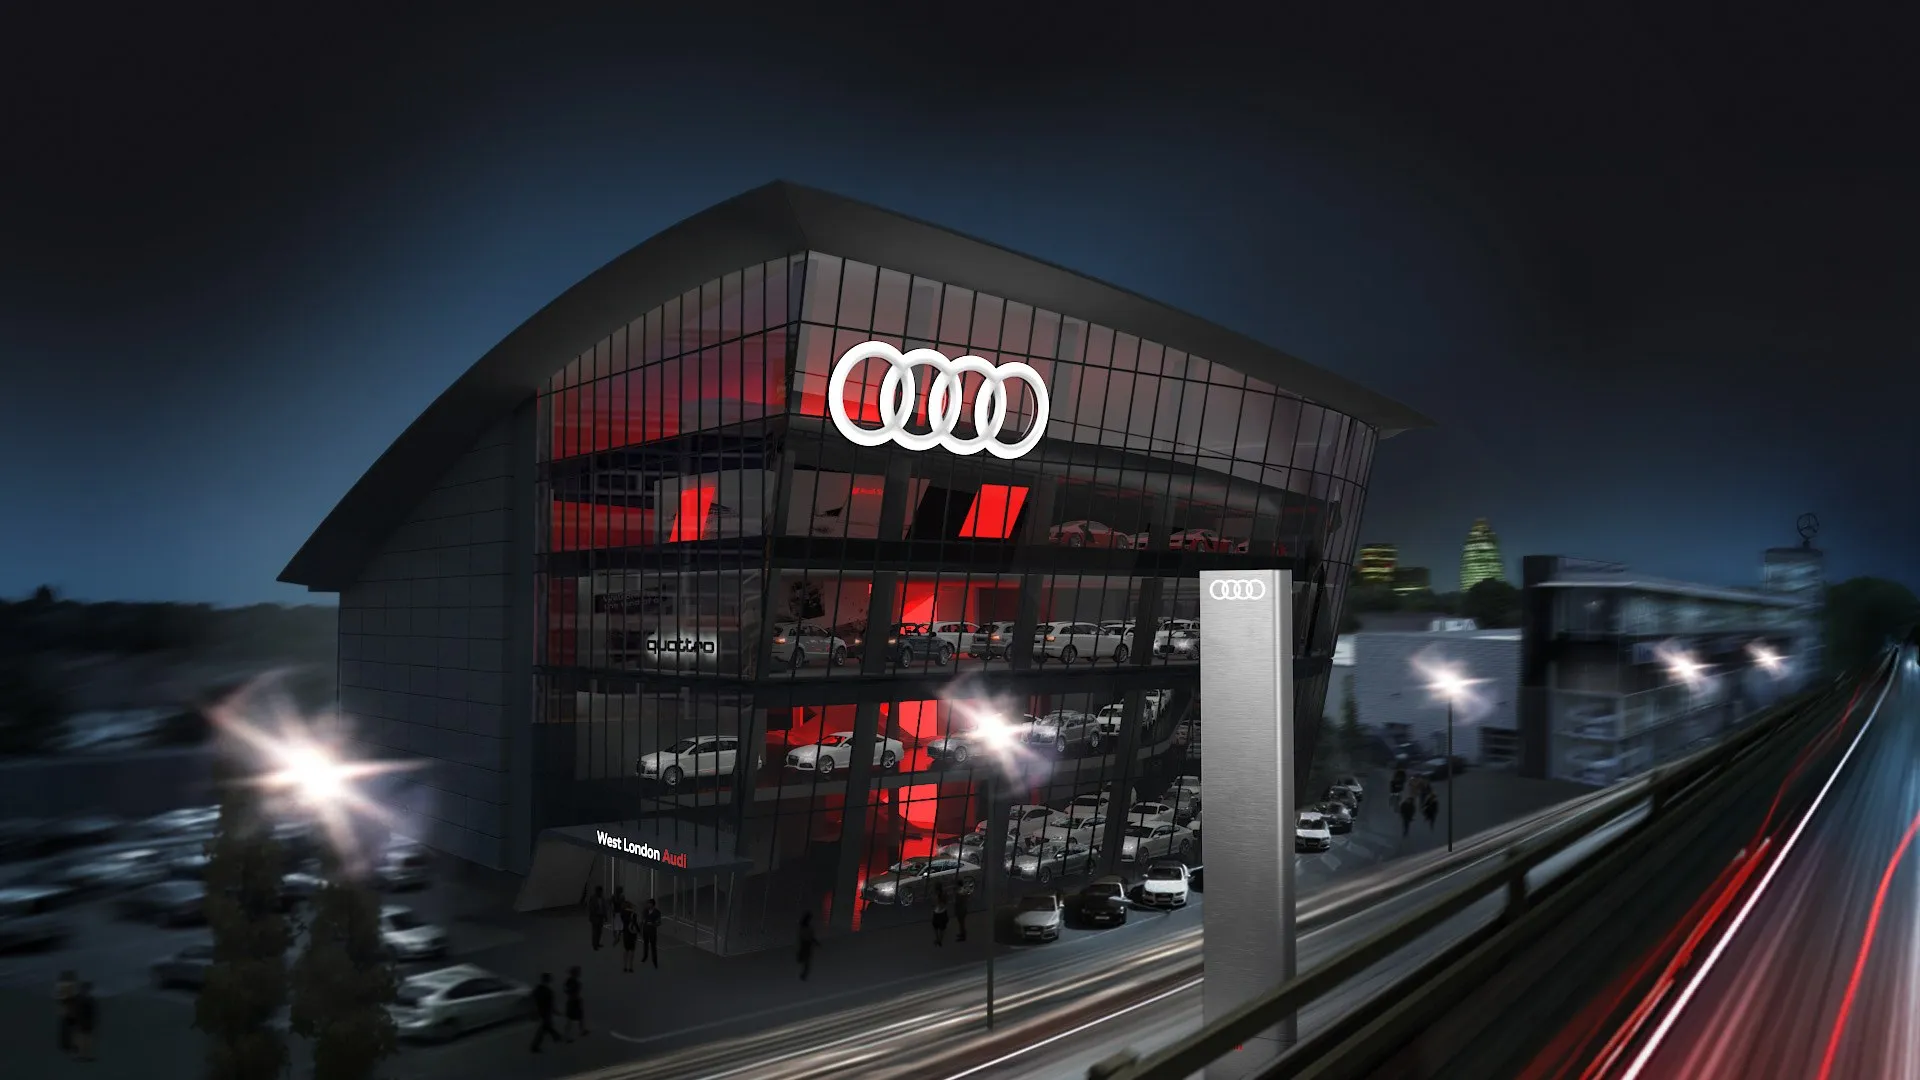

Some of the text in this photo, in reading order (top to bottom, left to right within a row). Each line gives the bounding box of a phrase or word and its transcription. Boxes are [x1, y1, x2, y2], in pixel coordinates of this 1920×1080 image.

[647, 638, 714, 654] quattro
[597, 830, 687, 868] West London Audi
